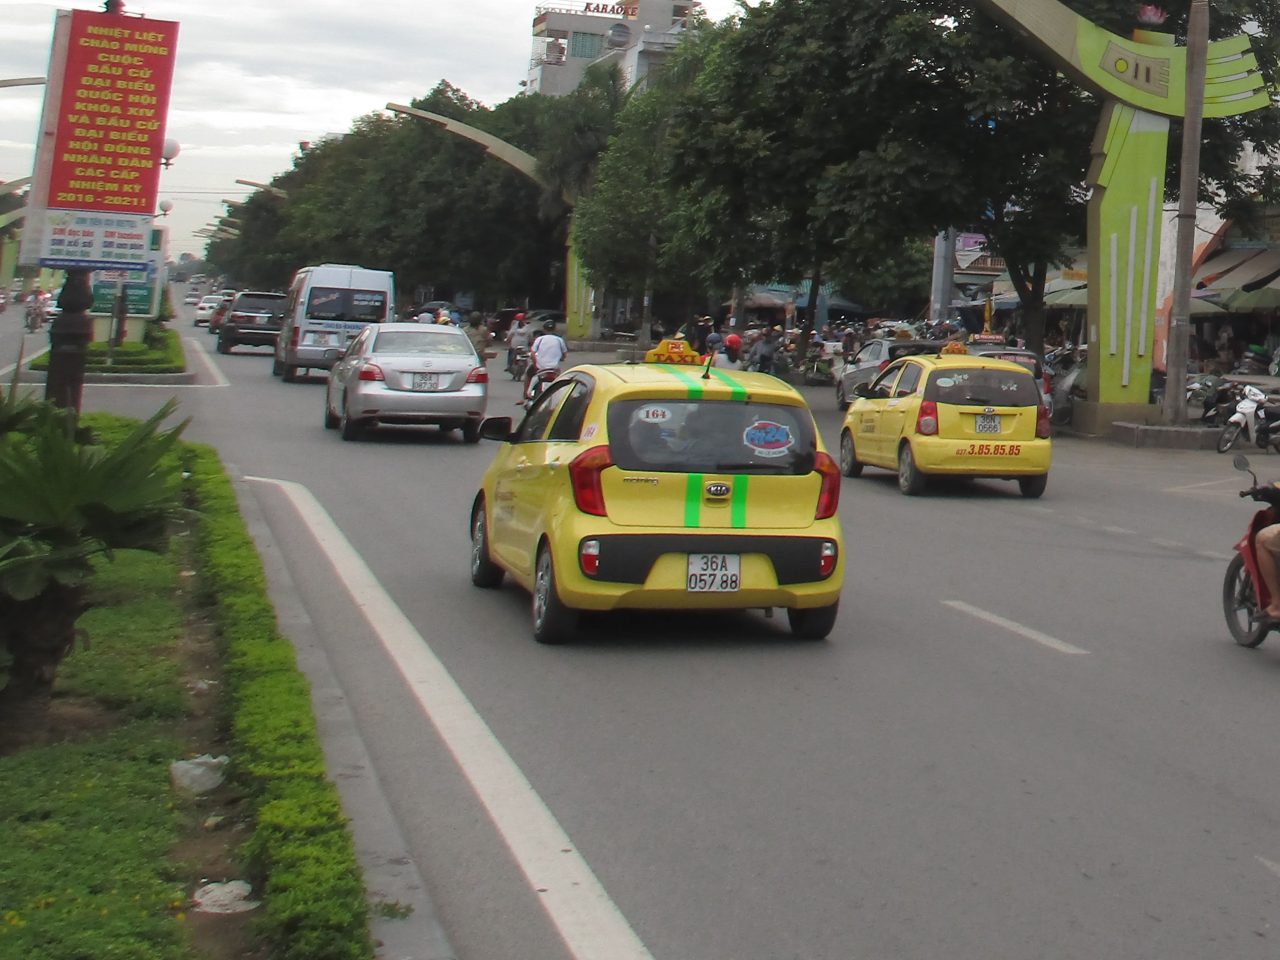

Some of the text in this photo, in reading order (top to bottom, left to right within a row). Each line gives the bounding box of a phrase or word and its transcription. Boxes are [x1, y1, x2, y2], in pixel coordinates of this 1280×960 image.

[583, 2, 638, 17] KARAOKE
[98, 52, 144, 65] CUỘC
[128, 107, 155, 116] XIV
[57, 192, 94, 203] 2016
[653, 353, 697, 364] TAXI
[644, 410, 667, 419] 164
[710, 484, 728, 494] KIA
[700, 555, 728, 572] 36A
[688, 573, 739, 591] 057.88
